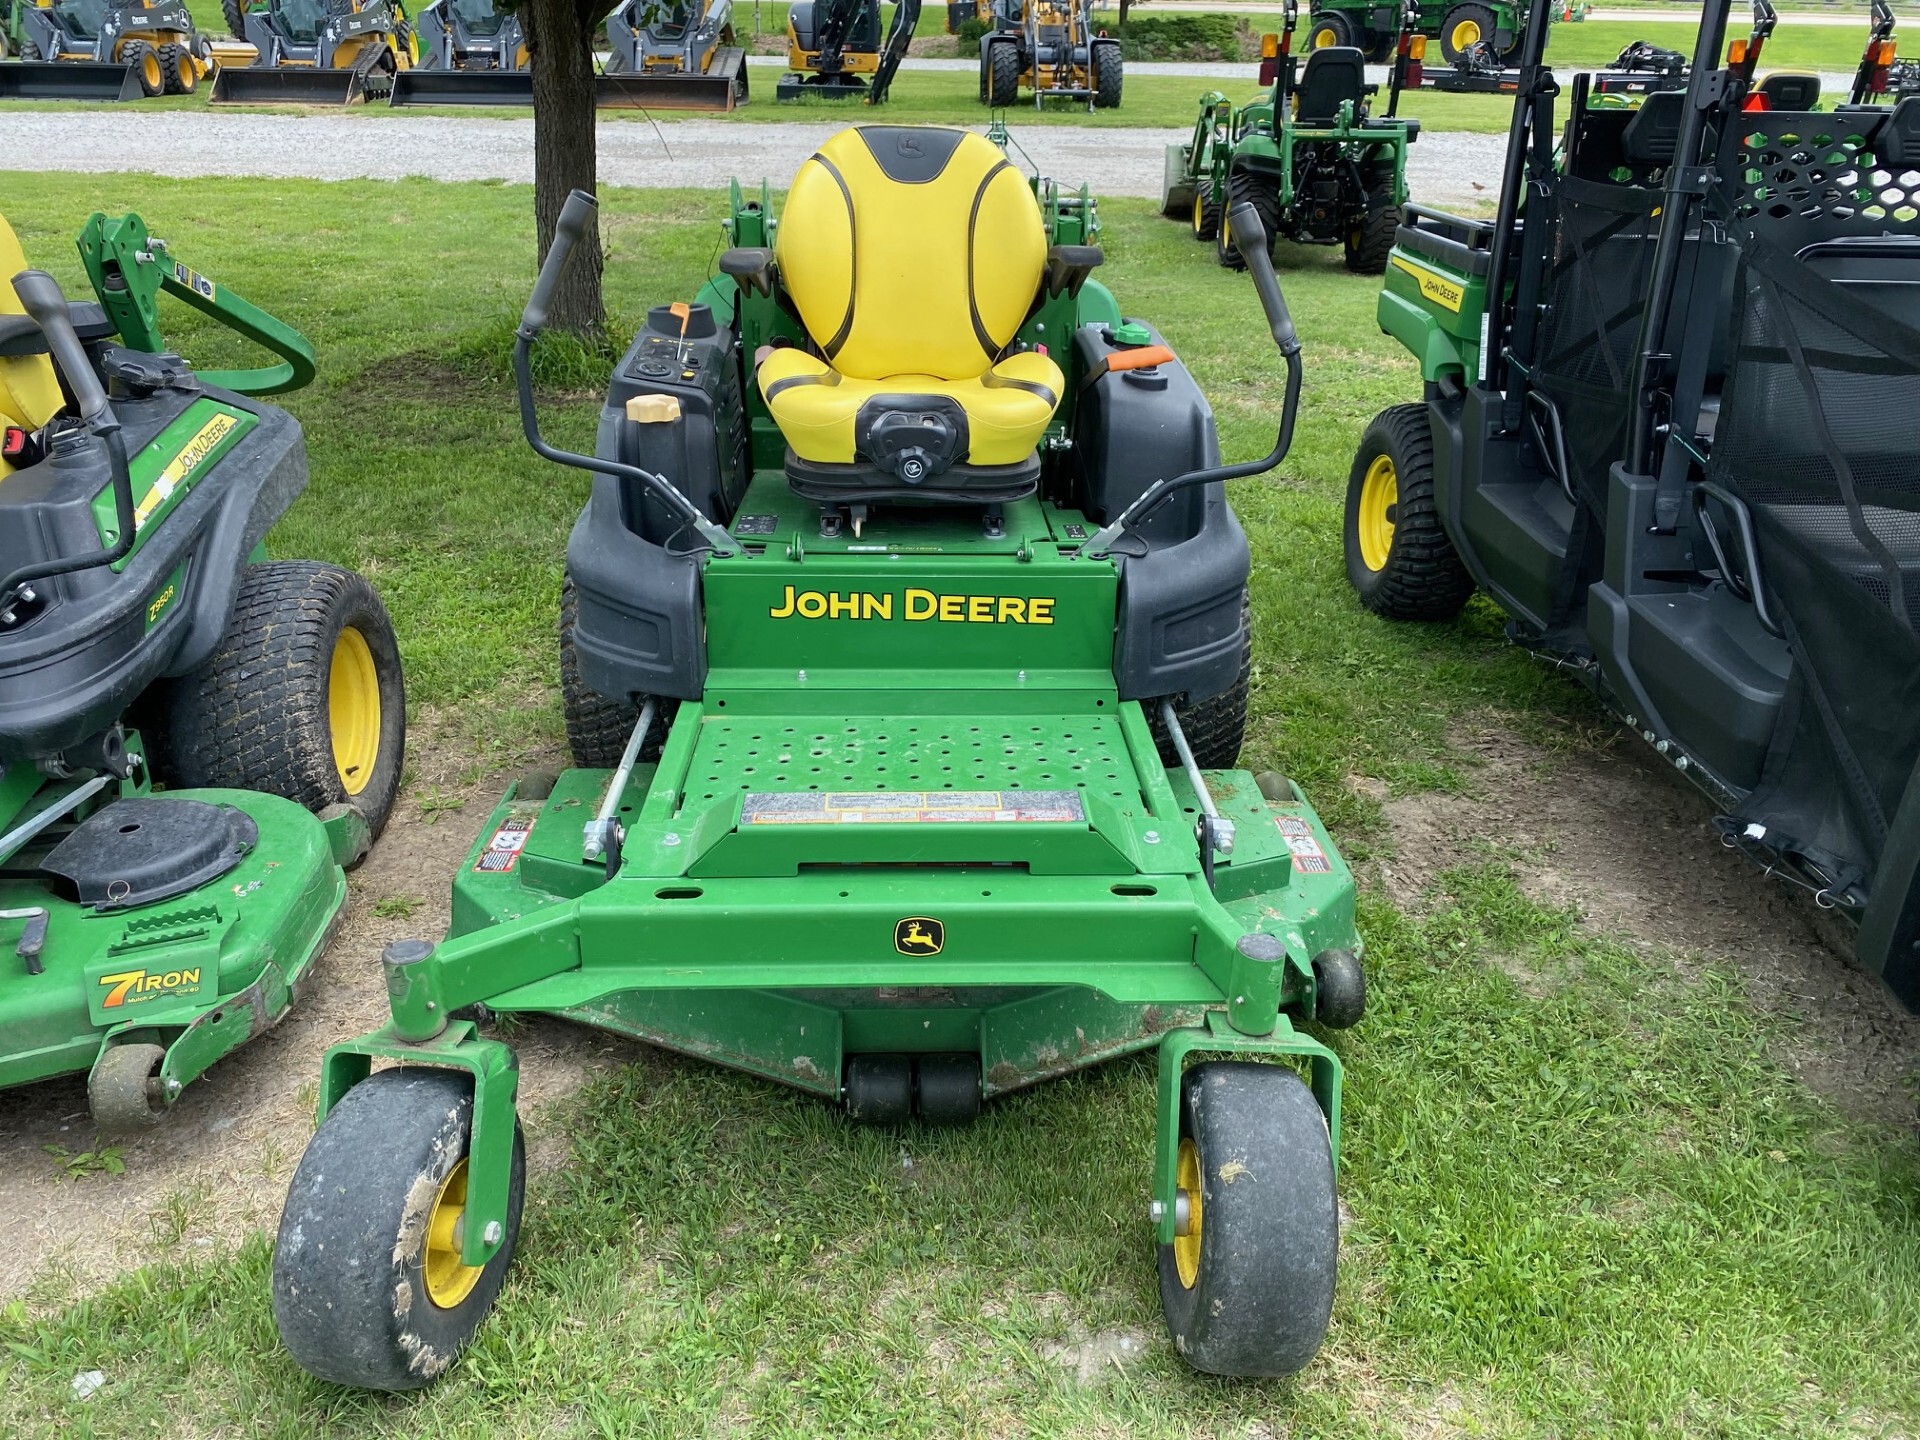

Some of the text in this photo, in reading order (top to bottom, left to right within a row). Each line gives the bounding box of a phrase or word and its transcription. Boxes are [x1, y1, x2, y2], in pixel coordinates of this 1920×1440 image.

[1424, 278, 1458, 303] JOHN DEERE
[178, 419, 228, 474] JOHN DEERE
[769, 585, 1056, 625] JOHN DEERE
